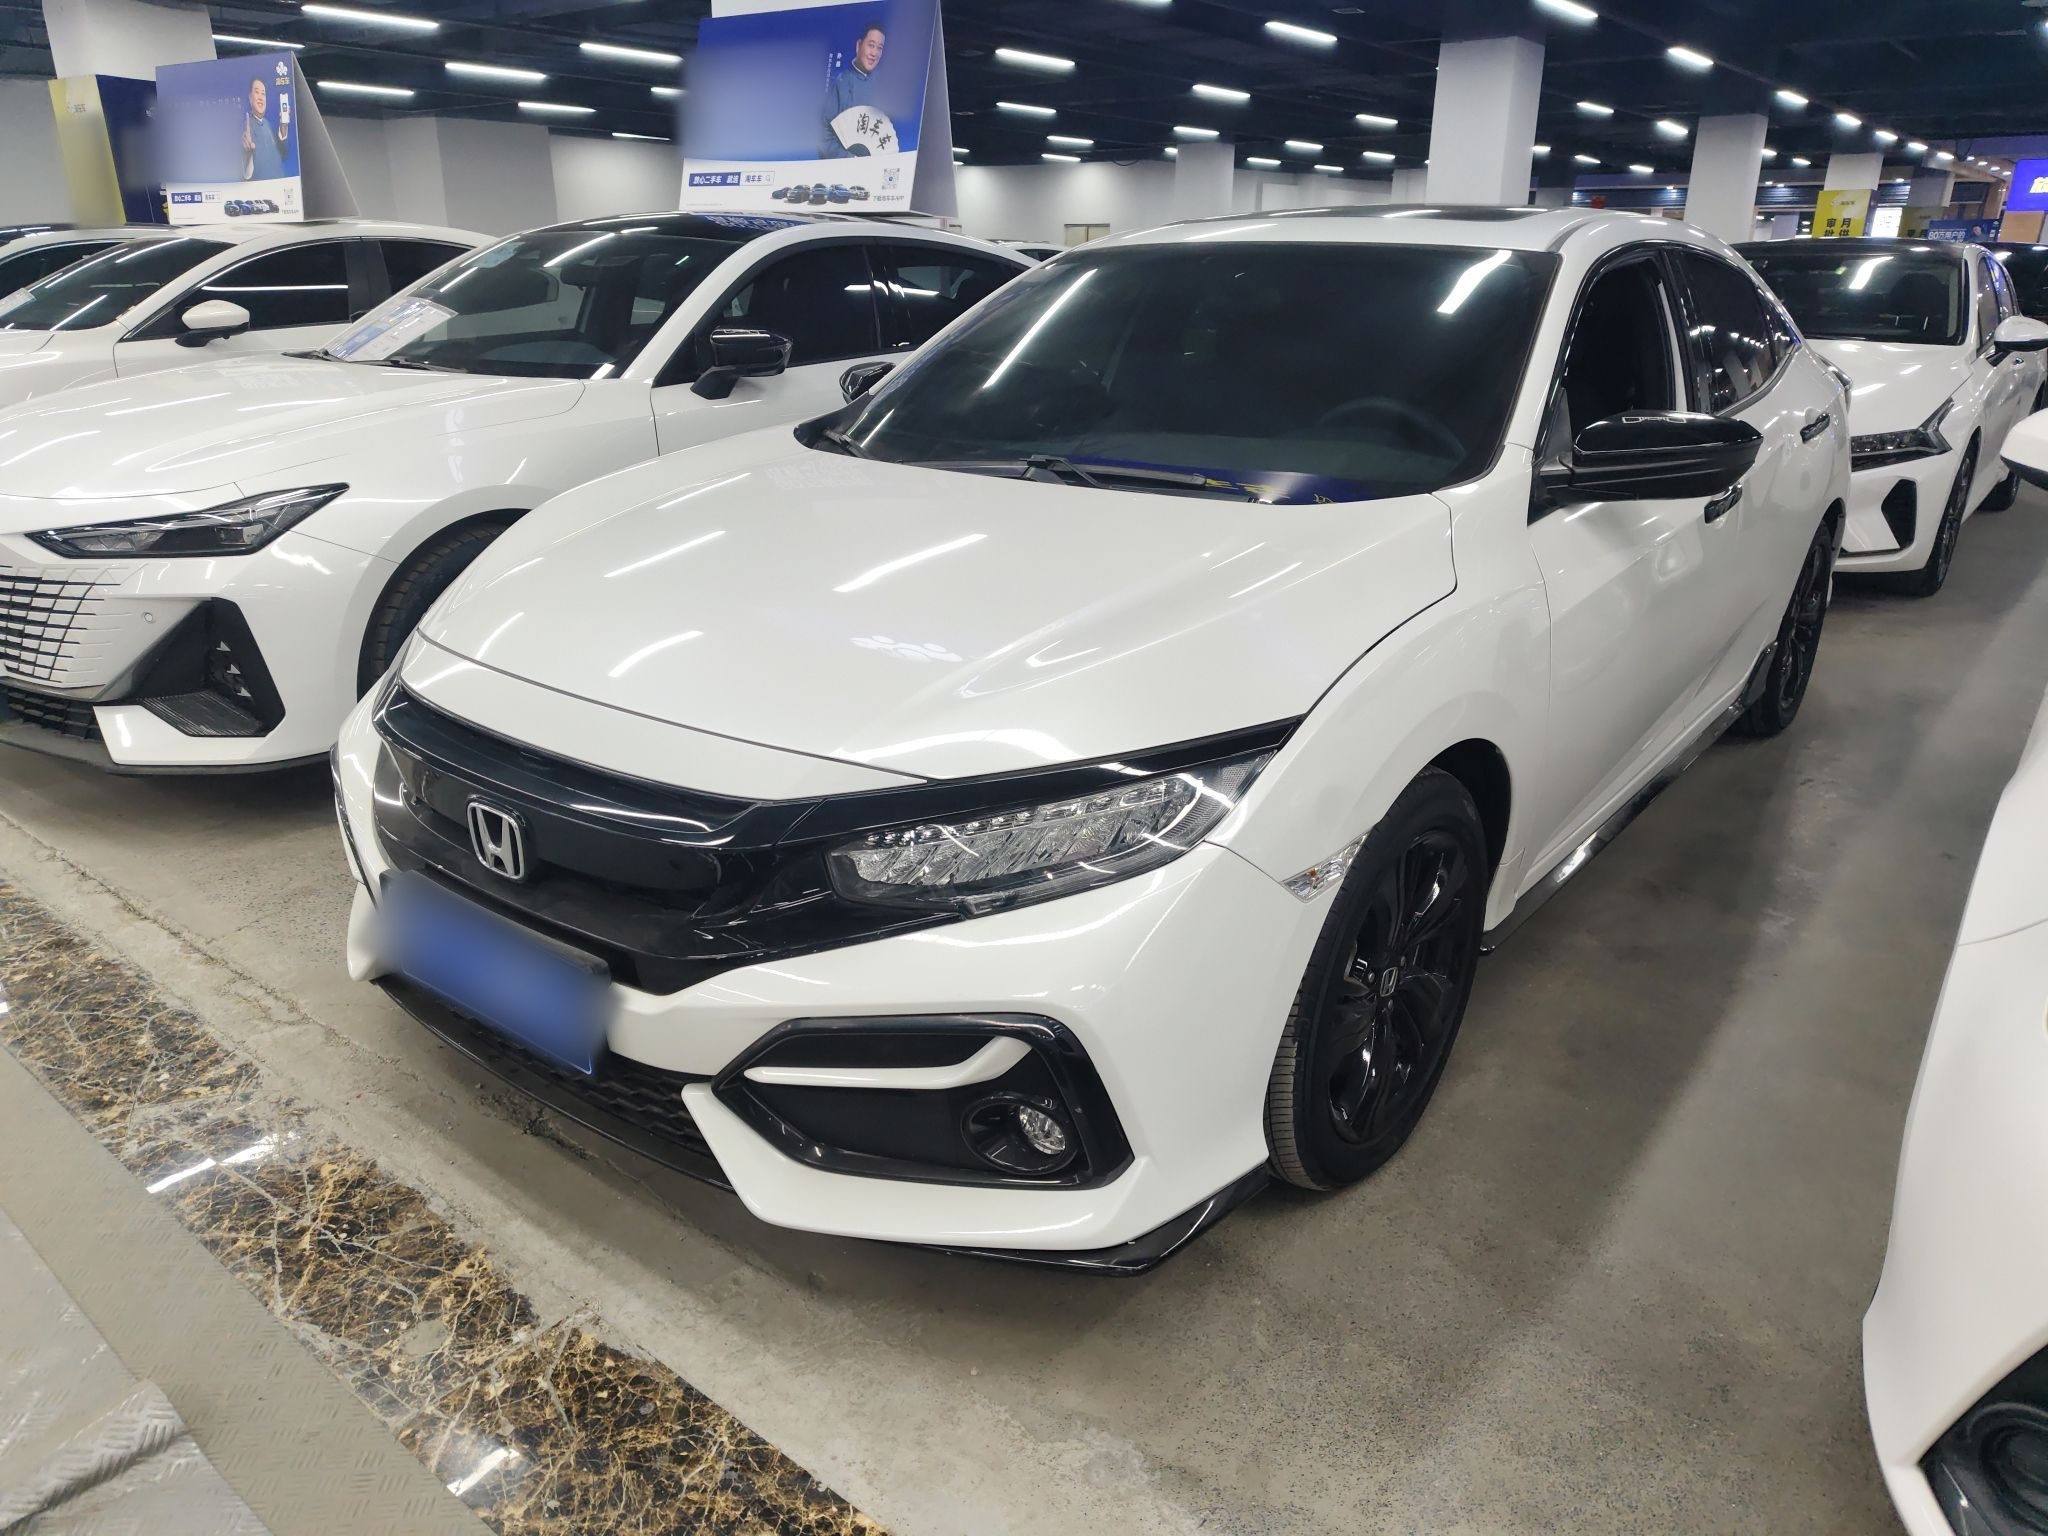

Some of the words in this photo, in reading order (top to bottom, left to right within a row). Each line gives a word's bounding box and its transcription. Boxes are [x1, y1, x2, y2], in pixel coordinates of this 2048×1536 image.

[693, 175, 723, 185] 放心二手车
